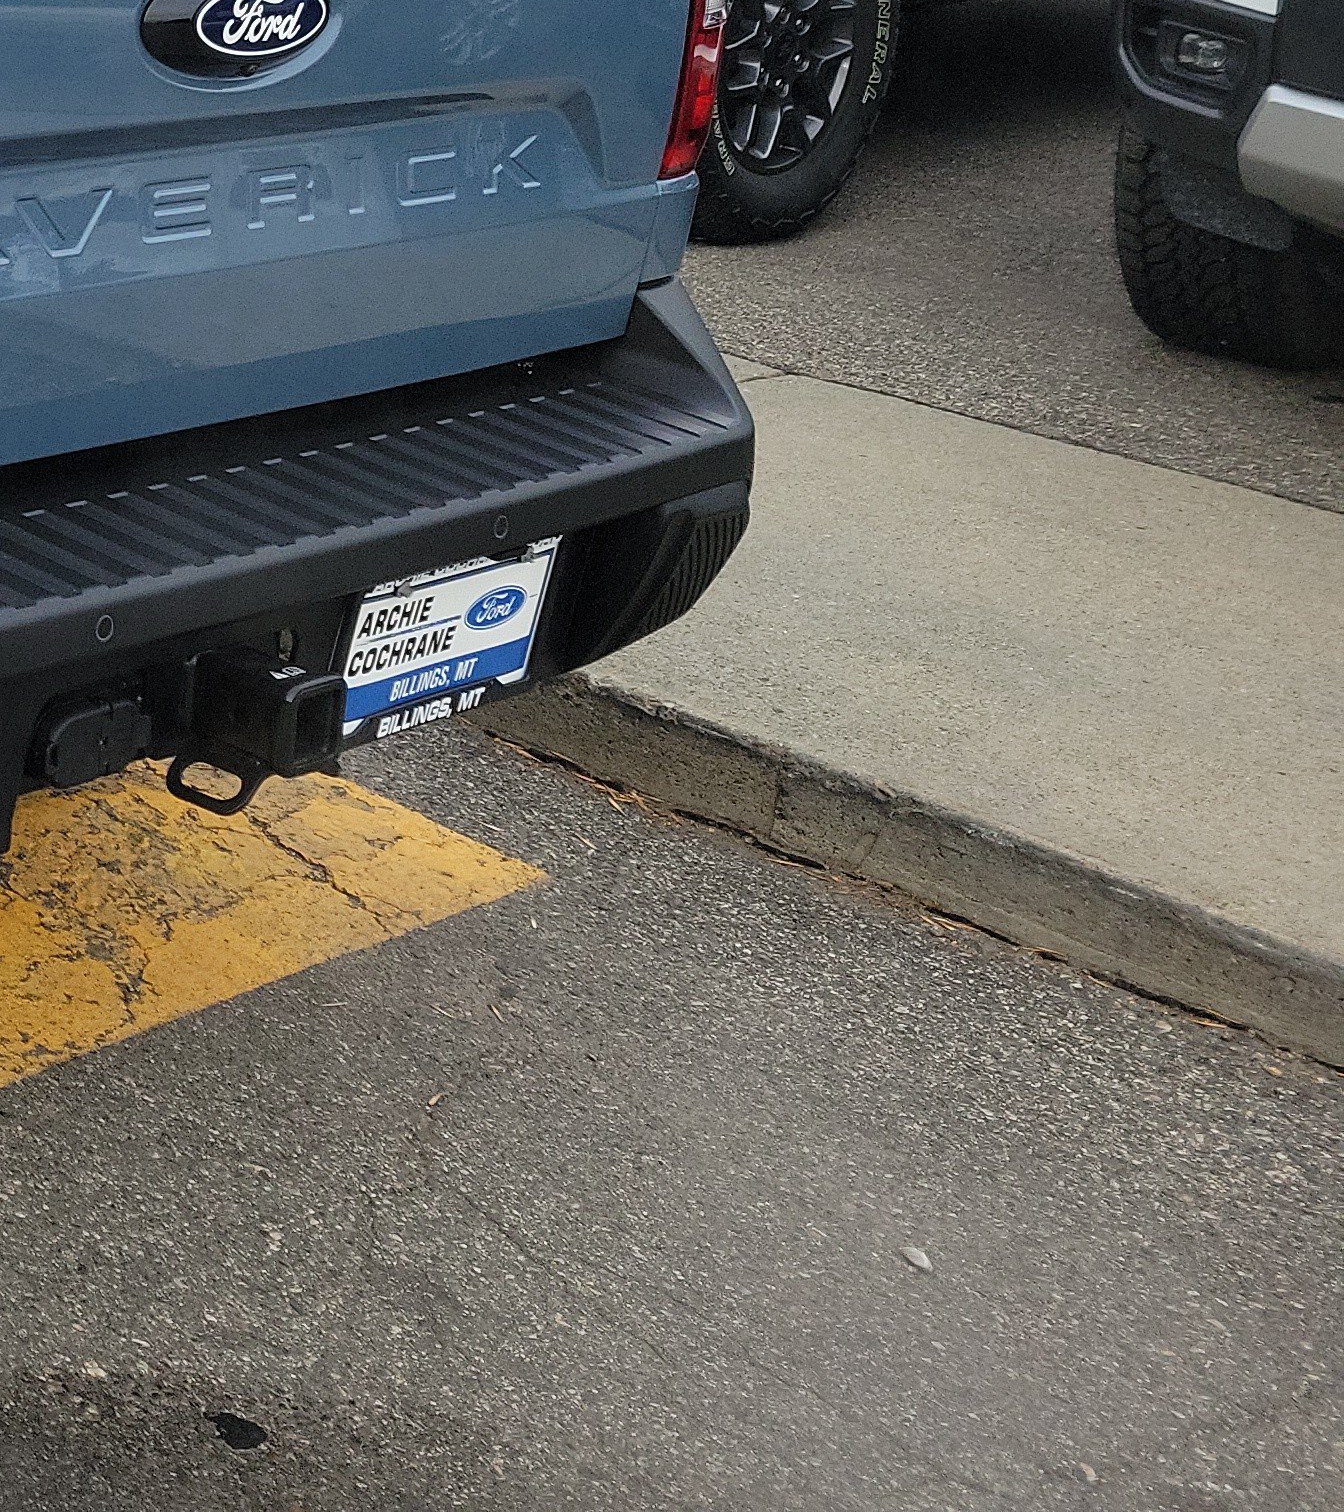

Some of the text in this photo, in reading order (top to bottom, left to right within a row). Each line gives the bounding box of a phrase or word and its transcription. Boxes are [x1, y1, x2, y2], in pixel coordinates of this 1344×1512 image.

[356, 595, 436, 640] ARCHIE
[476, 592, 514, 624] Ford
[347, 625, 458, 678] COCHRANE
[389, 657, 479, 702] BILLINGS, MT
[376, 686, 486, 739] BILLINGS, MT
